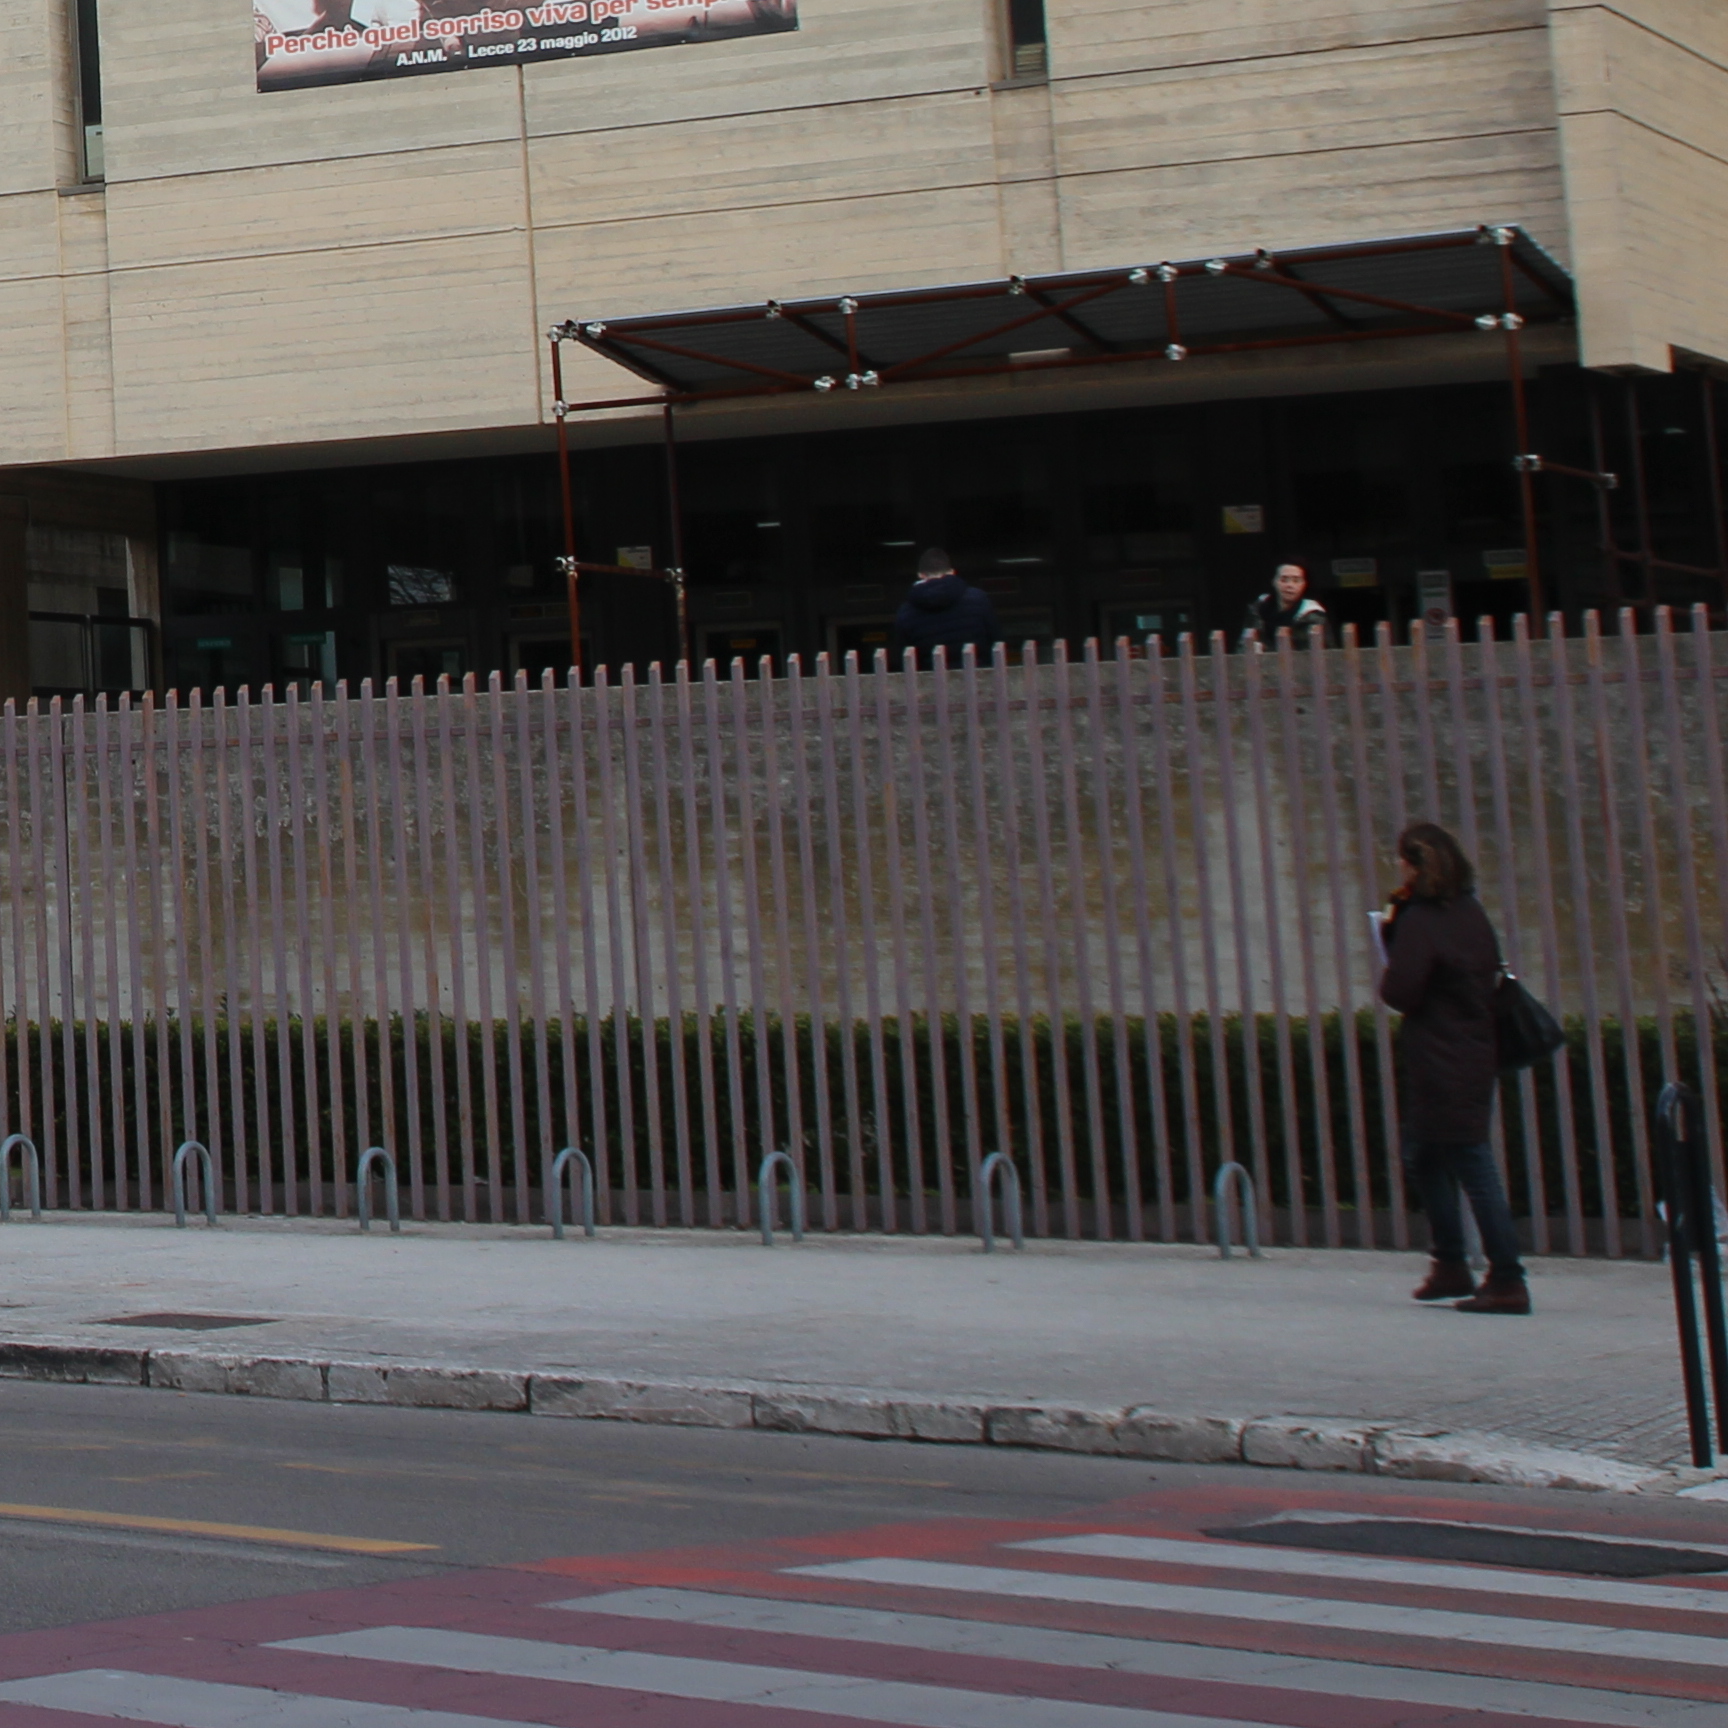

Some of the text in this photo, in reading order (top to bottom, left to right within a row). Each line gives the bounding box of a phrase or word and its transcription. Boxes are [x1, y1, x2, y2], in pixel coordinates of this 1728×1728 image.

[267, 24, 359, 56] Perchè
[364, 18, 419, 48] quel
[424, 10, 522, 37] sorriso
[528, 3, 586, 27] viva
[396, 48, 448, 67] A.N.M.
[468, 40, 515, 59] Lecce
[517, 37, 538, 53] 23
[540, 30, 599, 52] maggio
[601, 25, 638, 42] 2012
